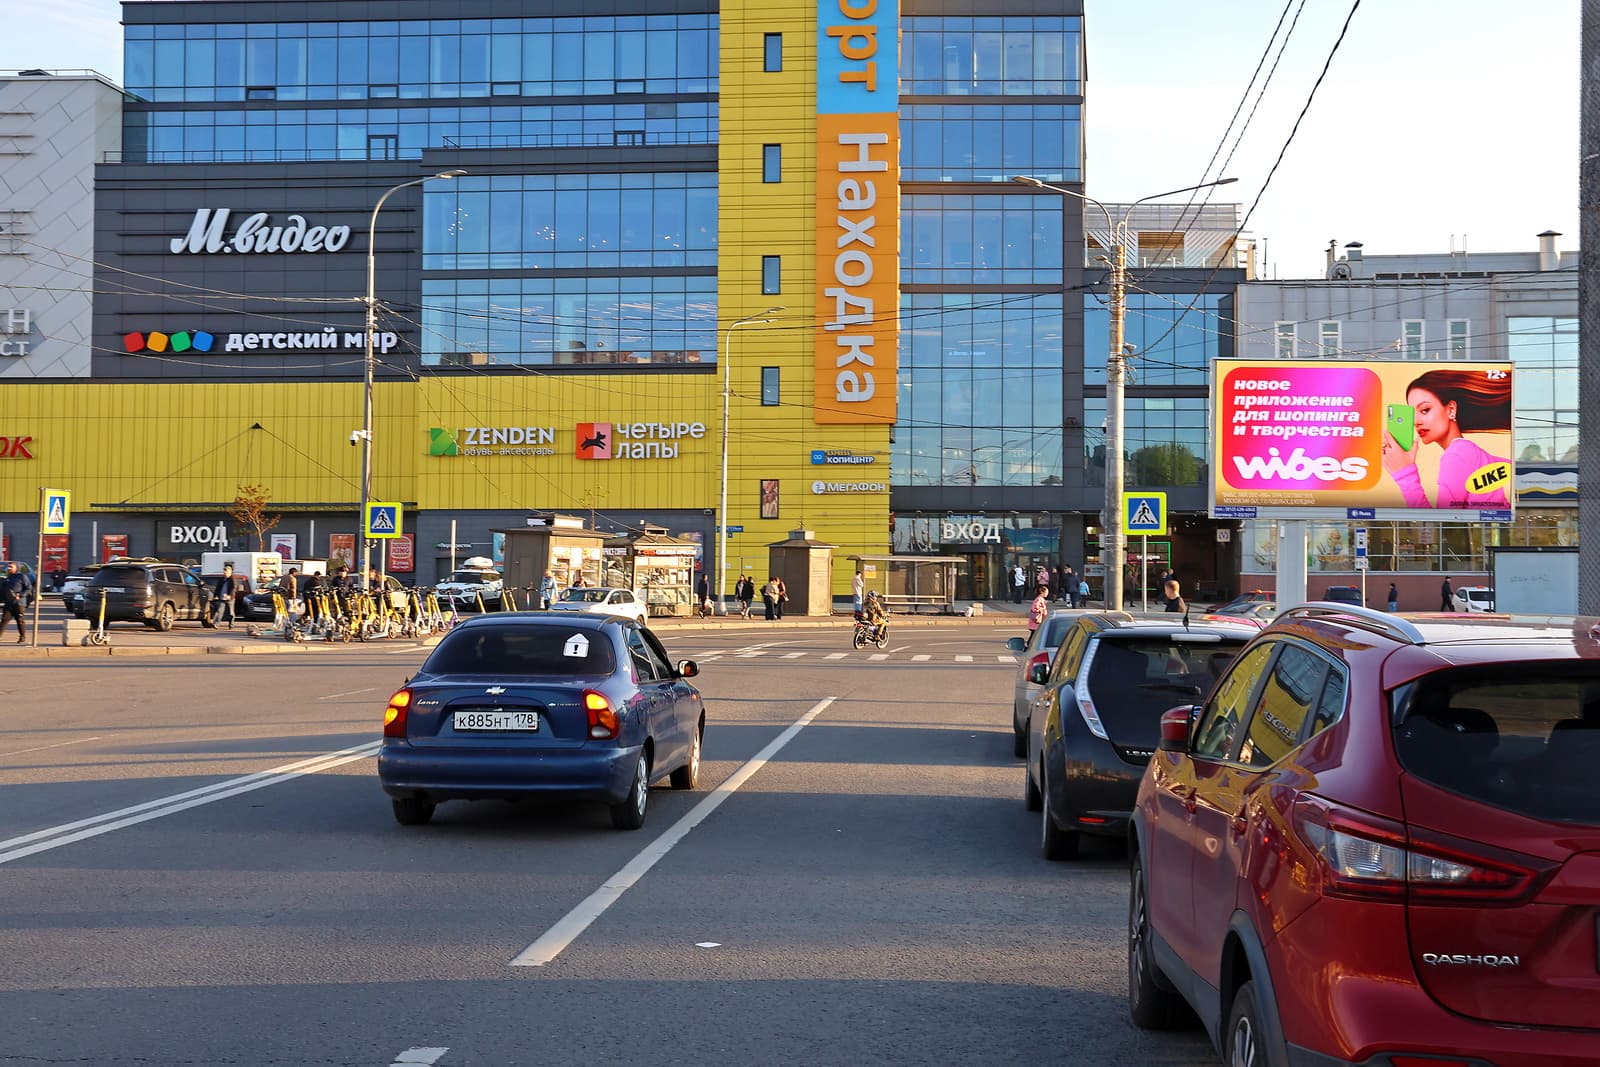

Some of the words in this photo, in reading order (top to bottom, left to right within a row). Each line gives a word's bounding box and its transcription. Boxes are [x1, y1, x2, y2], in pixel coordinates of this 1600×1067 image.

[170, 208, 350, 254] М.видео
[824, 133, 888, 402] Находка
[225, 327, 337, 352] детский
[345, 331, 398, 354] мир
[1486, 370, 1507, 379] 12+
[1234, 379, 1291, 391] новое
[1234, 395, 1354, 407] приложение
[1232, 410, 1269, 423] для
[1273, 410, 1360, 422] шопинга
[464, 427, 555, 445] ZENDEN
[615, 422, 706, 439] четыре
[1233, 425, 1246, 436] и
[1252, 425, 1365, 440] творчества
[464, 447, 493, 456] обувь
[615, 441, 679, 459] лапы
[827, 456, 874, 464] КОПИЦЕНТР
[1472, 465, 1508, 491] LIKE
[171, 526, 228, 547] ВХОД
[943, 523, 1001, 543] ВХОД
[459, 714, 511, 728] К885НТ
[514, 714, 533, 724] 178
[1422, 953, 1520, 967] QASHQAI
